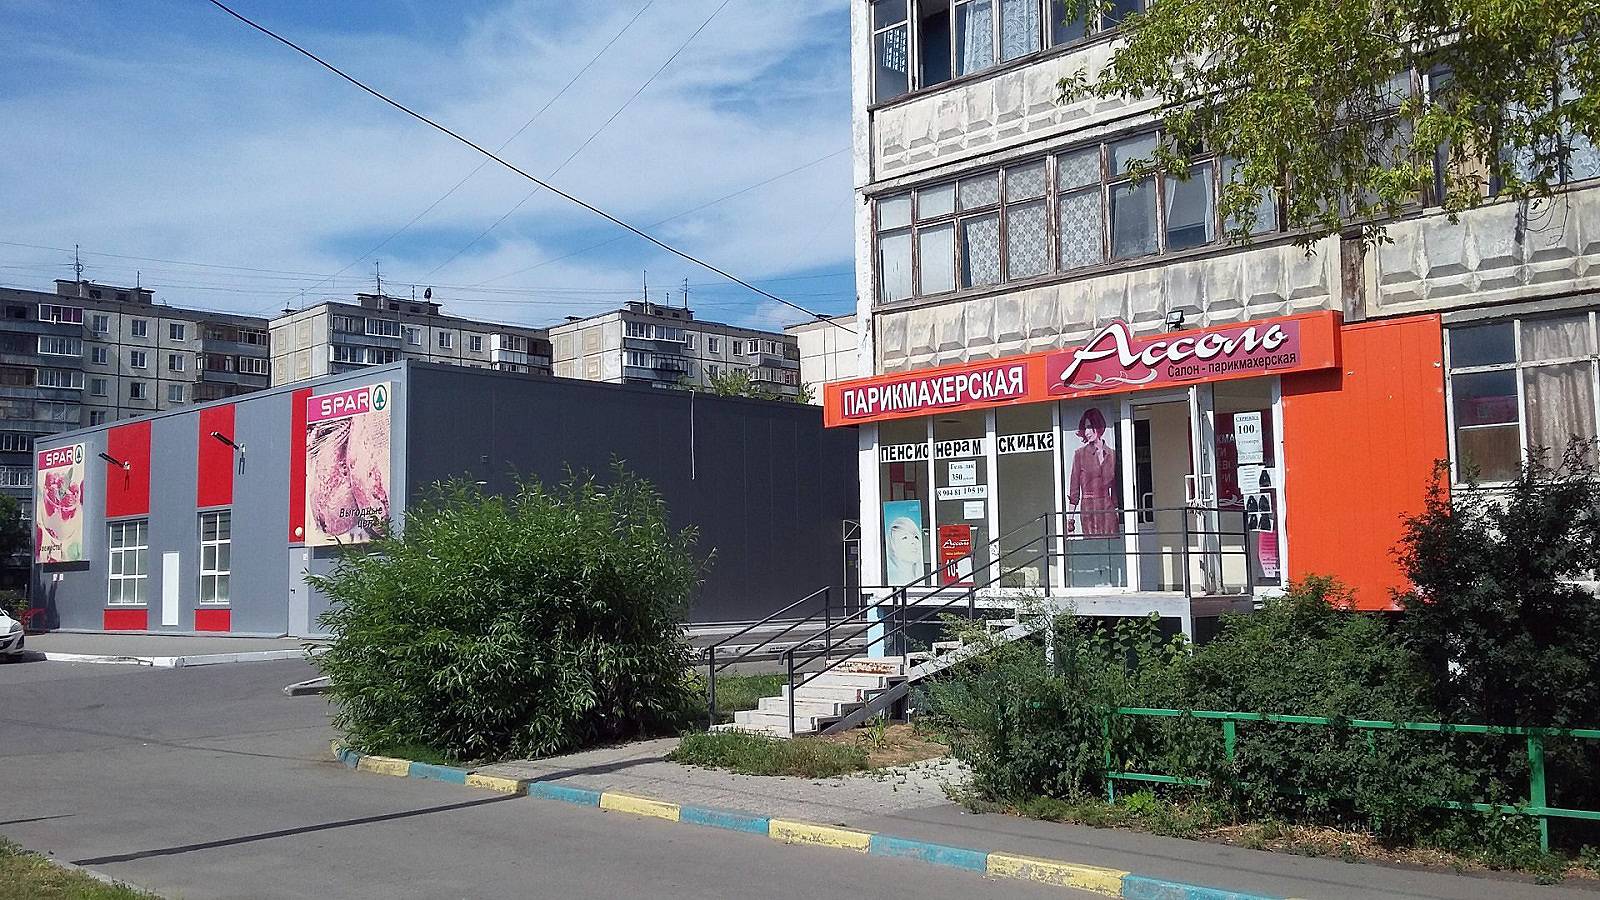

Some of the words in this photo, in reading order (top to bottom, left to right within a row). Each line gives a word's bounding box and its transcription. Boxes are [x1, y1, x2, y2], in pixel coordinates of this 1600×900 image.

[1060, 322, 1289, 380] Ассоль
[1167, 364, 1200, 378] Салон
[1208, 352, 1297, 374] парикмахерская
[321, 391, 369, 416] SPAR
[843, 366, 1024, 416] ПАРИКМАХЕРСКАЯ
[1238, 424, 1255, 434] 100
[45, 450, 73, 466] SPAR
[951, 473, 963, 481] 350
